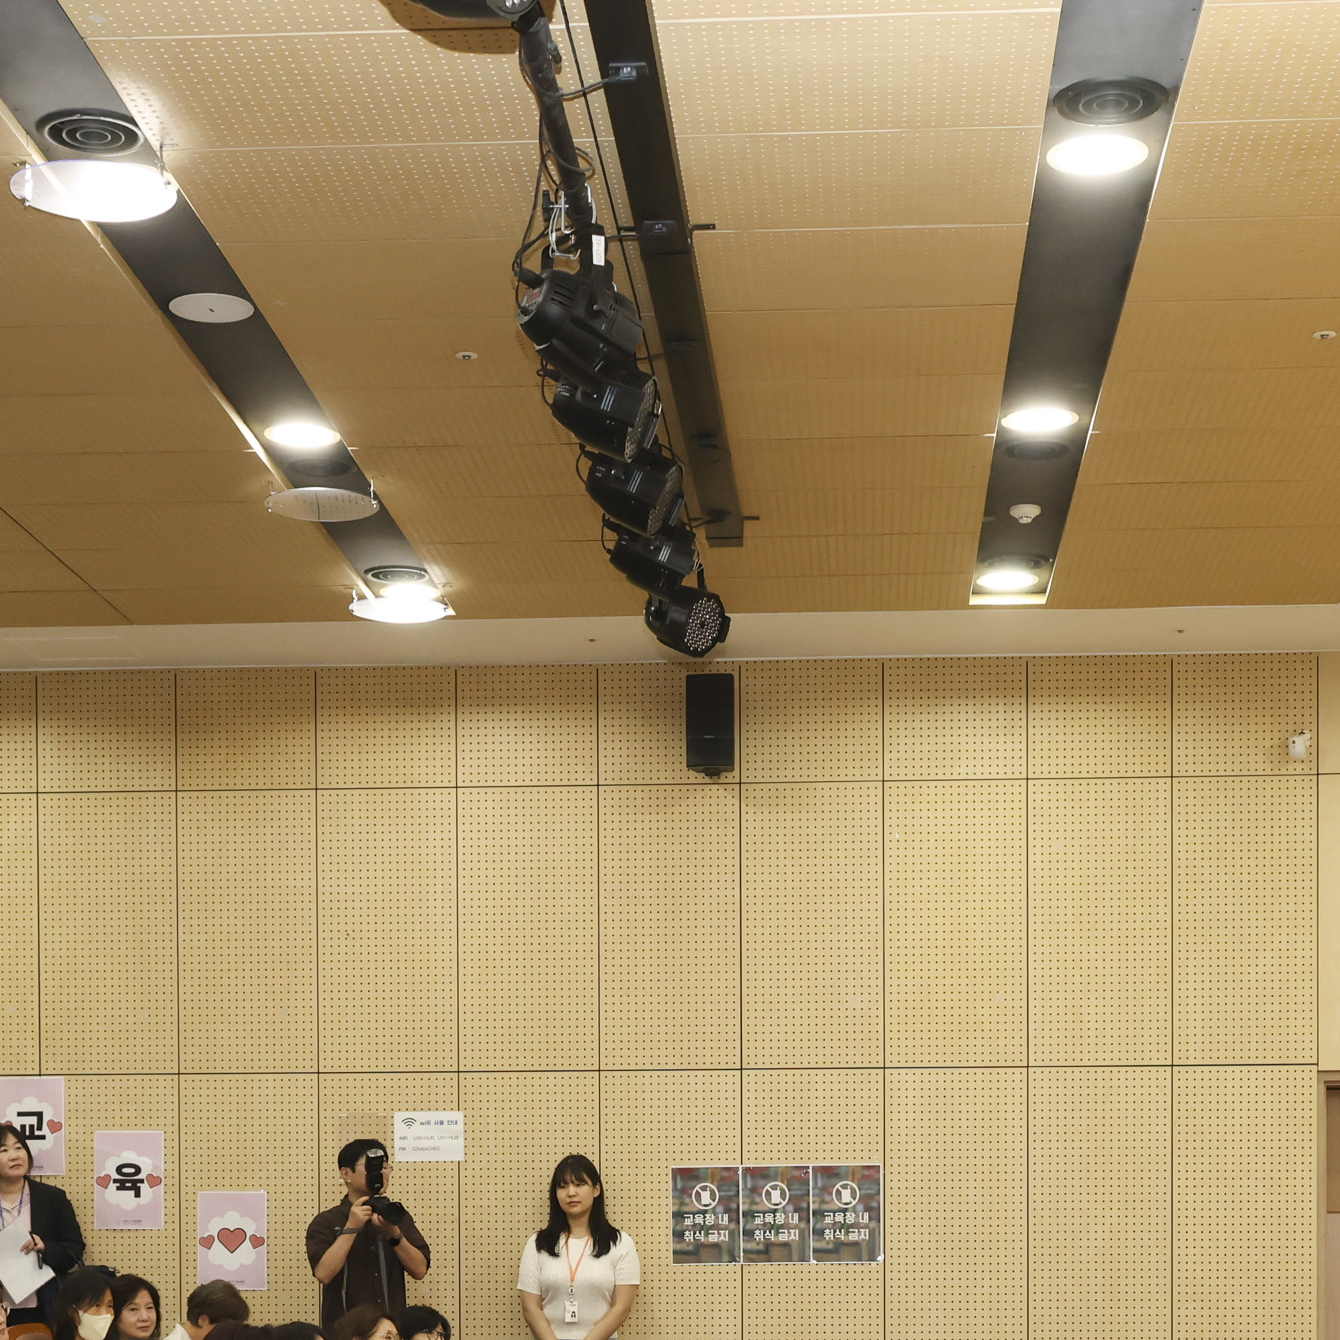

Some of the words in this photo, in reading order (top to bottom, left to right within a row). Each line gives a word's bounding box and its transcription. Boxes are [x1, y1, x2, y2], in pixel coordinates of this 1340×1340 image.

[17, 1111, 46, 1140] 교
[113, 1163, 144, 1198] 육
[684, 1214, 715, 1225] 교육장
[719, 1214, 728, 1225] 내
[754, 1213, 785, 1224] 교육장
[789, 1213, 798, 1224] 내
[824, 1212, 855, 1223] 교육장
[859, 1212, 868, 1223] 내
[684, 1231, 704, 1241] 취식
[709, 1231, 729, 1241] 금지
[754, 1230, 774, 1240] 취식
[779, 1230, 799, 1240] 금지
[824, 1229, 844, 1239] 취식
[849, 1229, 869, 1239] 금지
